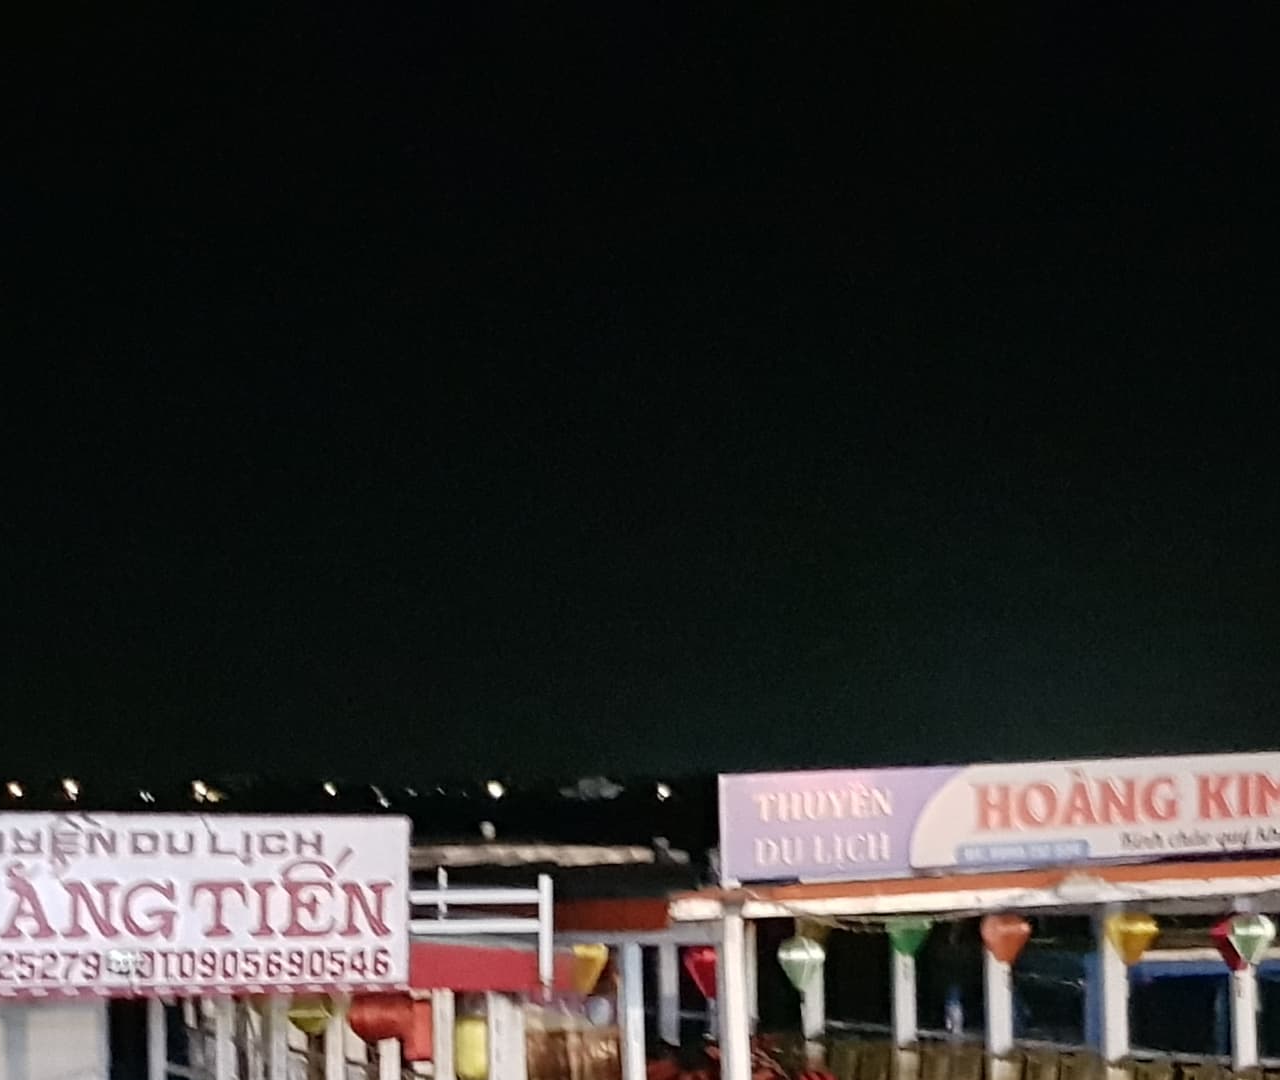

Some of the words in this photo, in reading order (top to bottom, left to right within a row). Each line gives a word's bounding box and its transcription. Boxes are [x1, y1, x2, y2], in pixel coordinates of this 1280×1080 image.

[753, 783, 894, 822] THUYỀN
[971, 768, 1179, 830] HOÀNG
[131, 831, 194, 854] DU
[210, 829, 323, 864] LỊCH
[754, 834, 803, 866] DU
[813, 832, 891, 871] LỊCH
[192, 847, 393, 937] TIẾN
